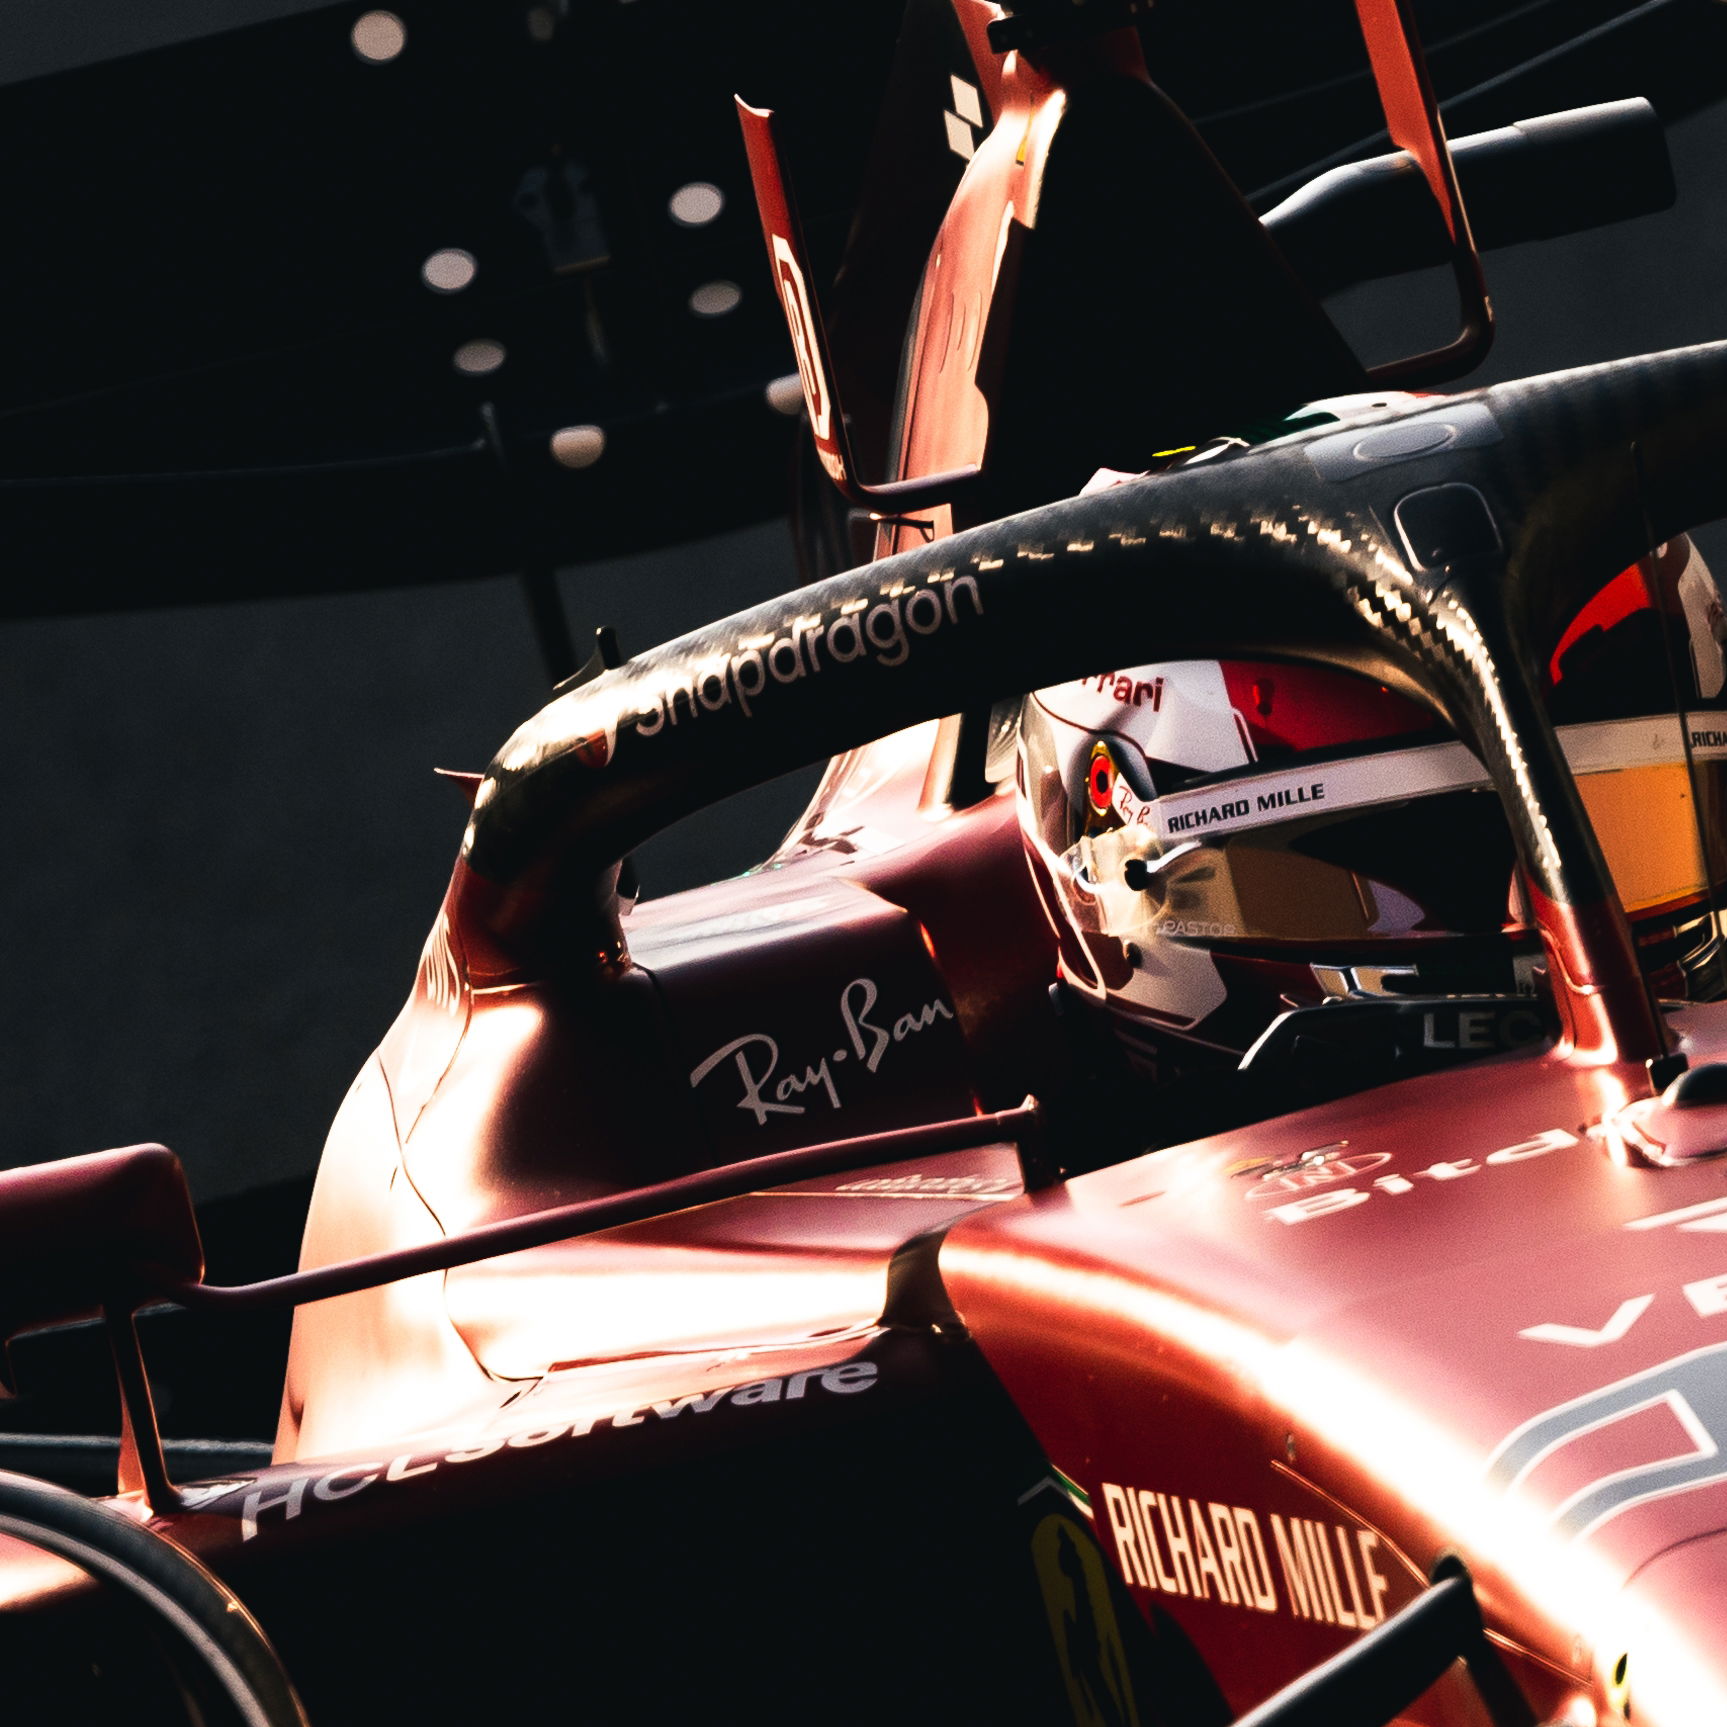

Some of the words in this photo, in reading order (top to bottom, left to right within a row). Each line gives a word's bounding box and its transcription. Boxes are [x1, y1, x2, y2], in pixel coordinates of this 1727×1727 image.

[1167, 799, 1250, 834] RICHARD
[1257, 783, 1325, 817] MILLE
[689, 976, 954, 1127] Ray-Ban
[1101, 1481, 1278, 1613] RICHARD
